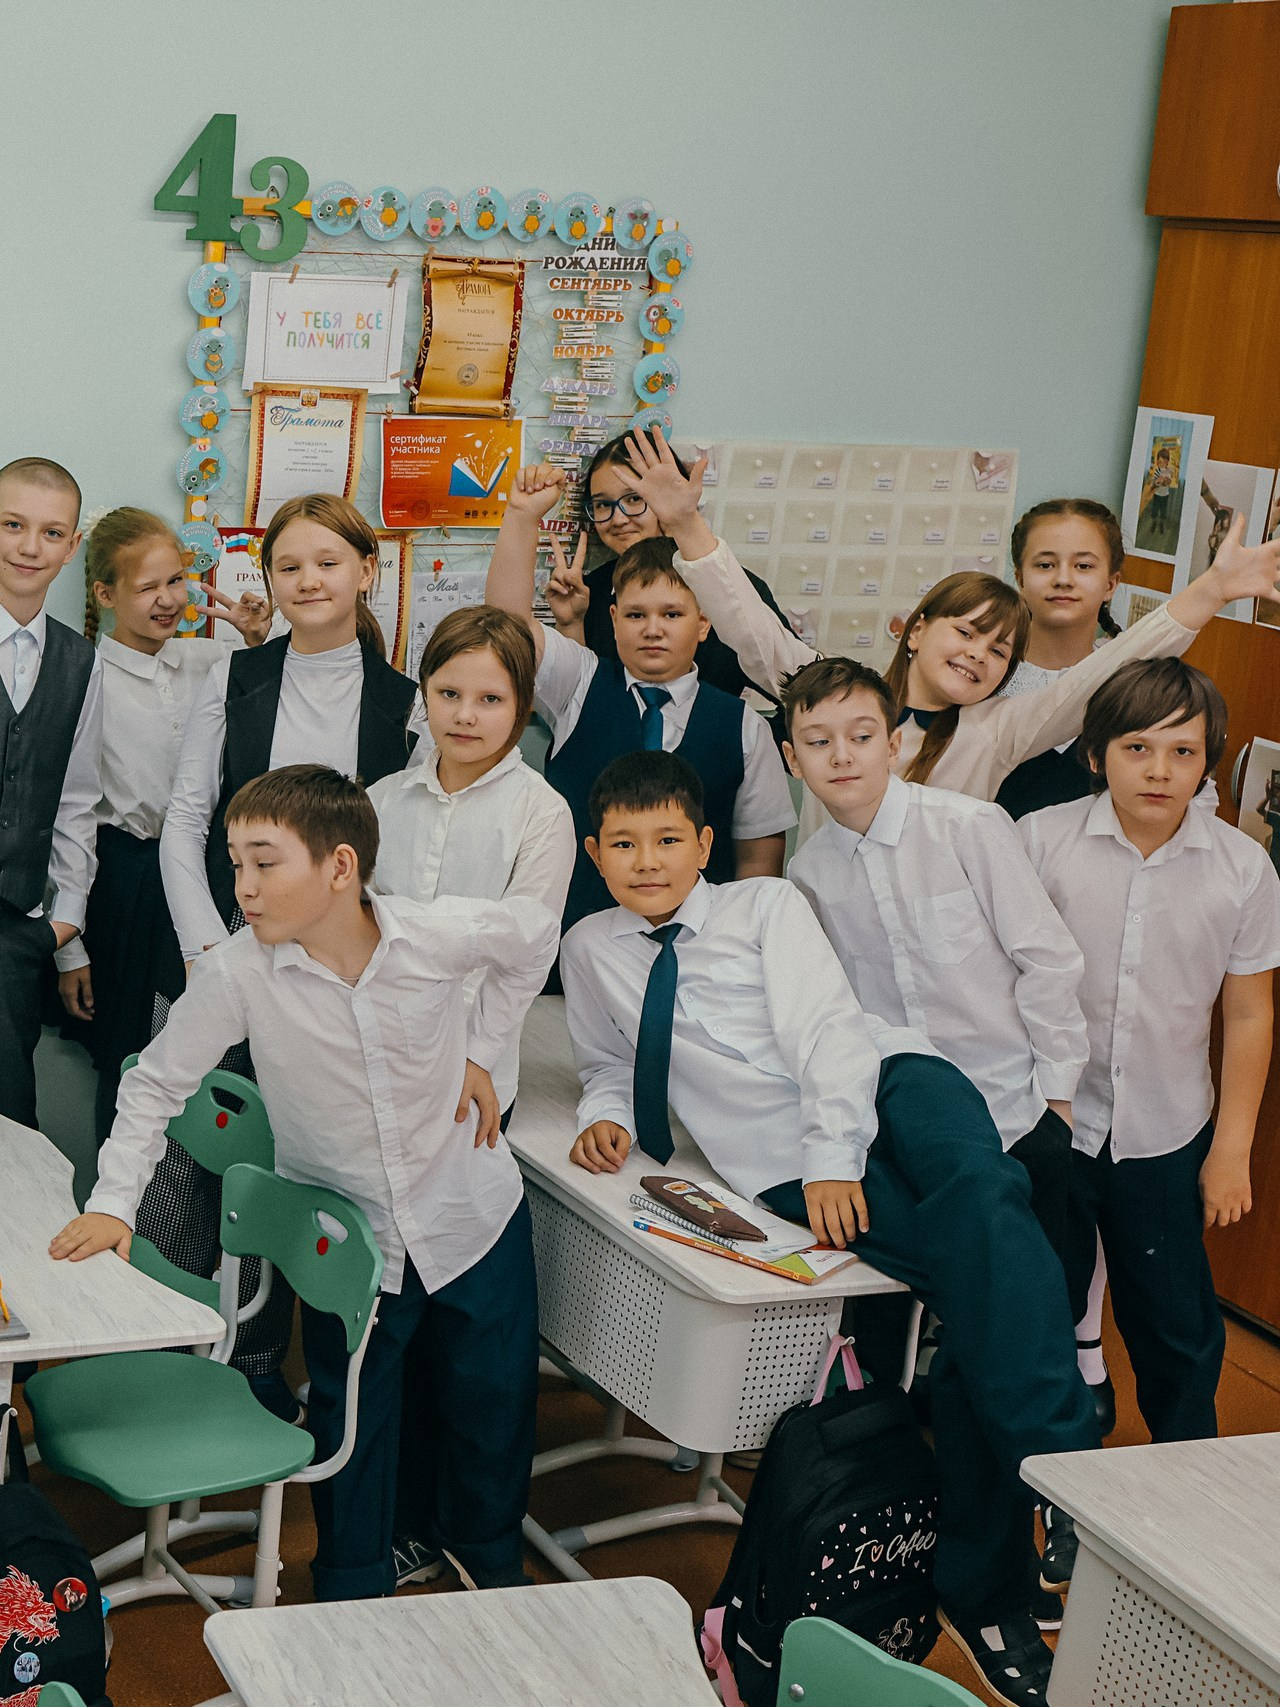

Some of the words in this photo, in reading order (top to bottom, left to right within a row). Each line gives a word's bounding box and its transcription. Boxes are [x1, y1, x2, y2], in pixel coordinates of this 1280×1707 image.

[576, 237, 616, 251] ДНИ
[543, 256, 647, 271] РОЖДЕНИЯ
[549, 277, 632, 290] СЕНТЯБРЬ
[276, 311, 286, 326] У
[301, 311, 342, 328] ТЕБЯ
[356, 310, 383, 329] ВСЁ
[552, 308, 624, 322] ОКТЯБРЬ
[287, 331, 370, 349] ПОЛУЧИТСЯ
[553, 345, 615, 358] НОЯБРЬ
[543, 379, 617, 395] ДЕКАБРЬ
[270, 405, 344, 432] Грамота
[549, 413, 609, 427] ЯНВАРЬ
[390, 434, 447, 444] сертификат
[391, 446, 440, 456] участника
[539, 439, 602, 456] ФЕВРАЛ
[565, 471, 586, 483] АР
[538, 519, 595, 534] АПРЕ
[236, 573, 264, 581] ГРАМ
[426, 578, 459, 592] Май
[849, 1539, 878, 1574] I
[886, 1529, 937, 1567] Coffee
